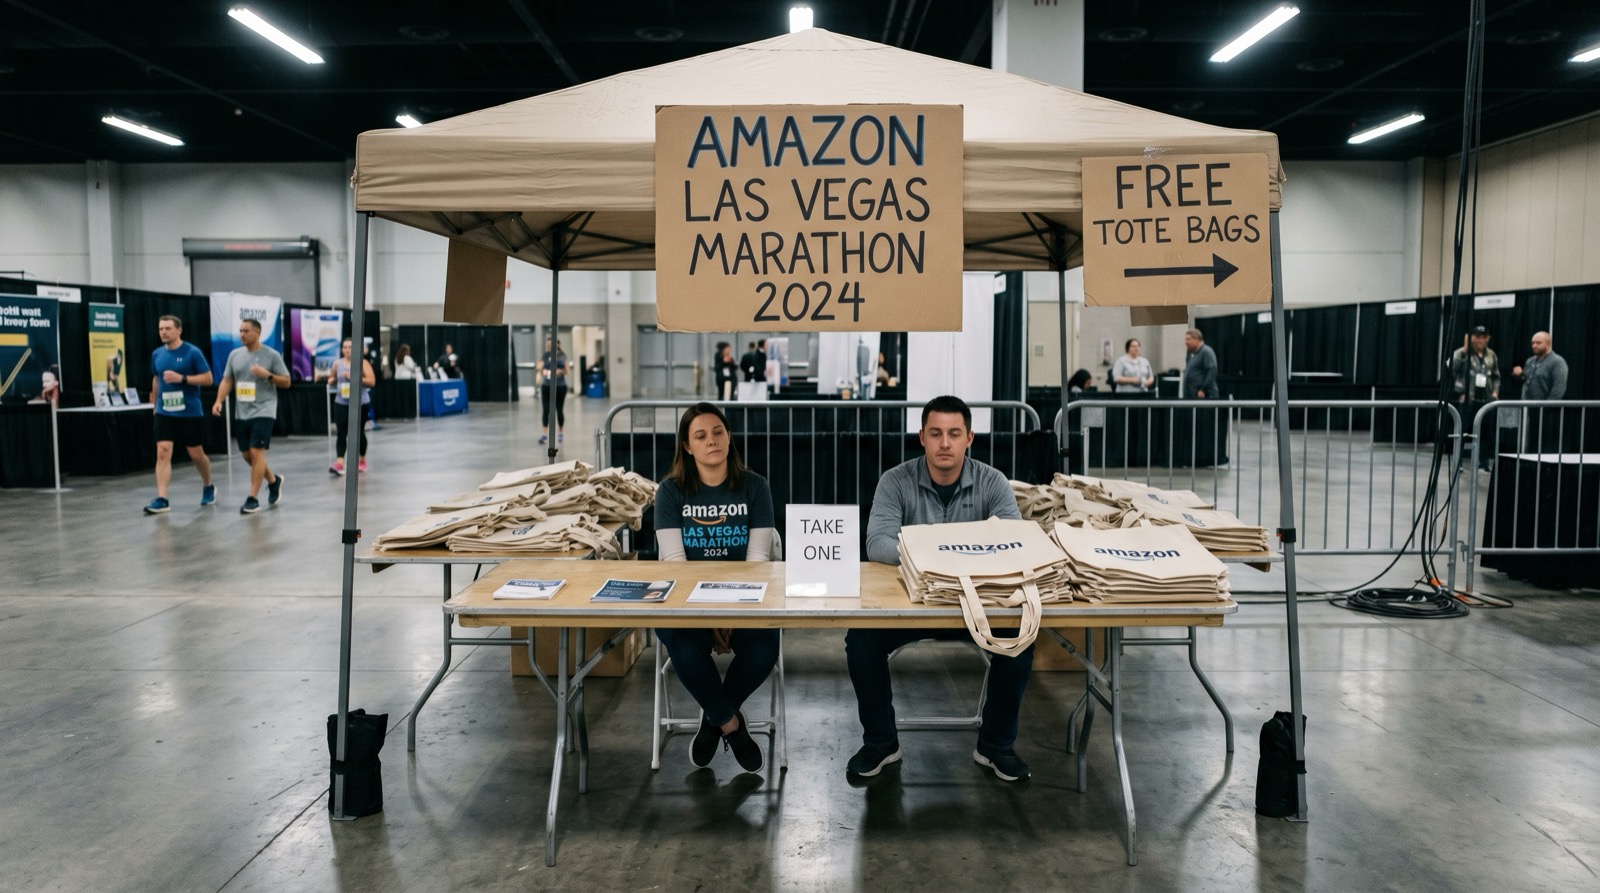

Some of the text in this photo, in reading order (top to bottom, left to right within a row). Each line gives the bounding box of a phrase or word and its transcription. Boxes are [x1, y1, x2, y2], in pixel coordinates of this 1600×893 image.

[686, 114, 925, 168] AMAZON
[1115, 162, 1233, 209] FREE
[684, 177, 930, 222] LAS VEGAS
[1092, 213, 1261, 246] TOTE BAGS
[688, 230, 926, 276] MARATHON
[753, 281, 865, 322] 2024
[682, 503, 748, 517] amazon
[683, 525, 748, 537] LAS VEGAS
[800, 519, 844, 534] TAKE
[683, 536, 748, 548] MARATHON
[938, 541, 1023, 552] amazon
[703, 548, 729, 557] 2024
[803, 545, 842, 560] ONE
[1093, 546, 1181, 559] amazon
